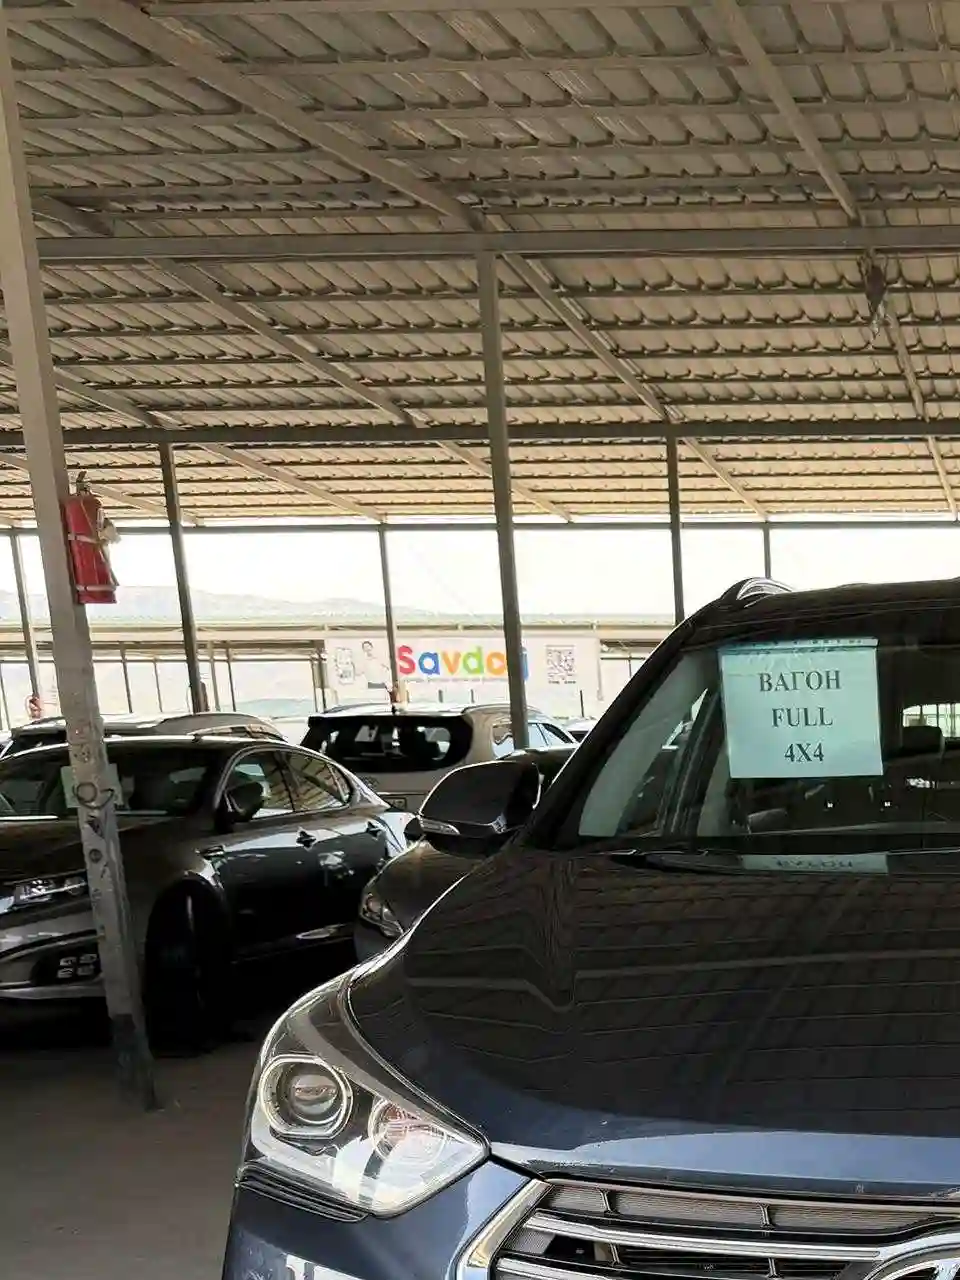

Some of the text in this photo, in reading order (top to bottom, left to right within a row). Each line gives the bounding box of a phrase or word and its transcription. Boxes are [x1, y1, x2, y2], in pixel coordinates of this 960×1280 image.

[759, 670, 842, 692] ВАГОН
[771, 706, 834, 728] FULL
[784, 742, 825, 763] 4X4
